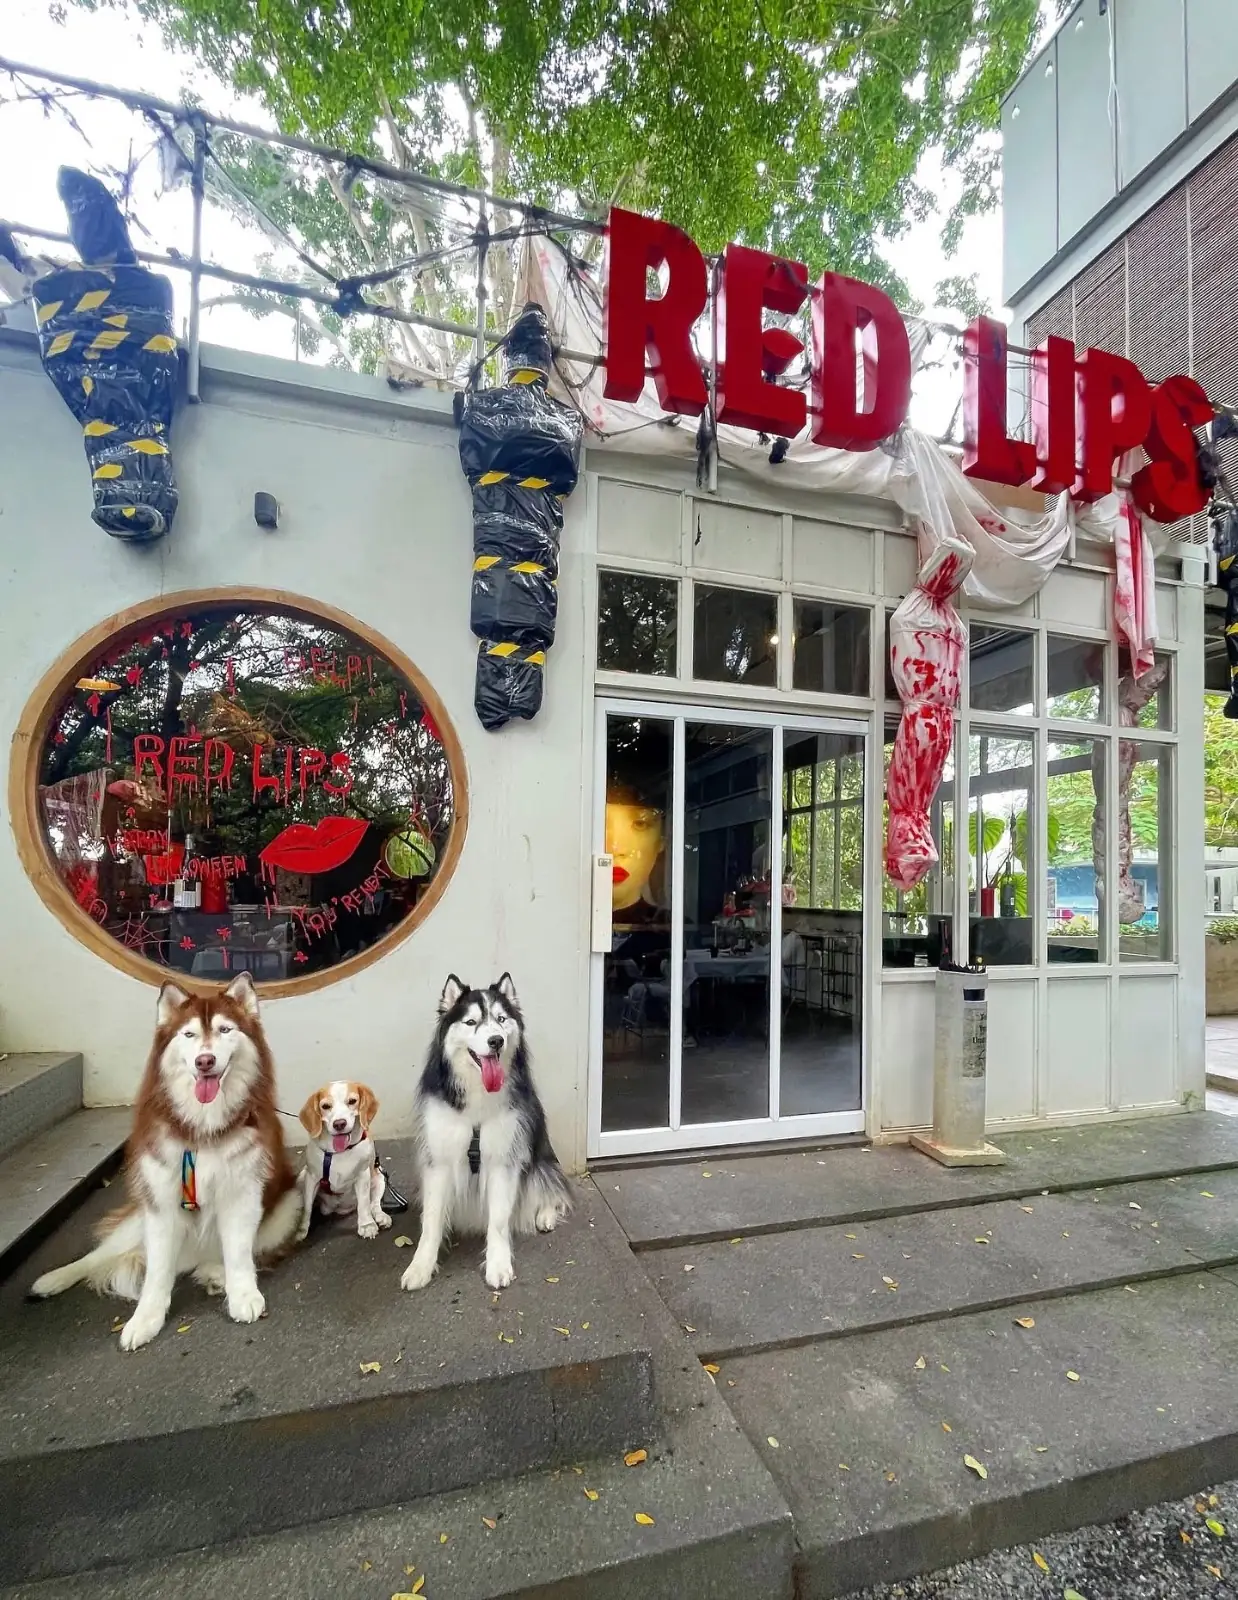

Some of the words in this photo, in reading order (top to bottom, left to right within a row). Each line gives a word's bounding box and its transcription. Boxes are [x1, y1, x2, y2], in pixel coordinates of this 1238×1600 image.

[603, 207, 911, 451] RED
[962, 315, 1215, 523] LIPS
[134, 734, 234, 794] RED
[252, 744, 354, 797] LIPS
[292, 889, 362, 936] YOU'RE
